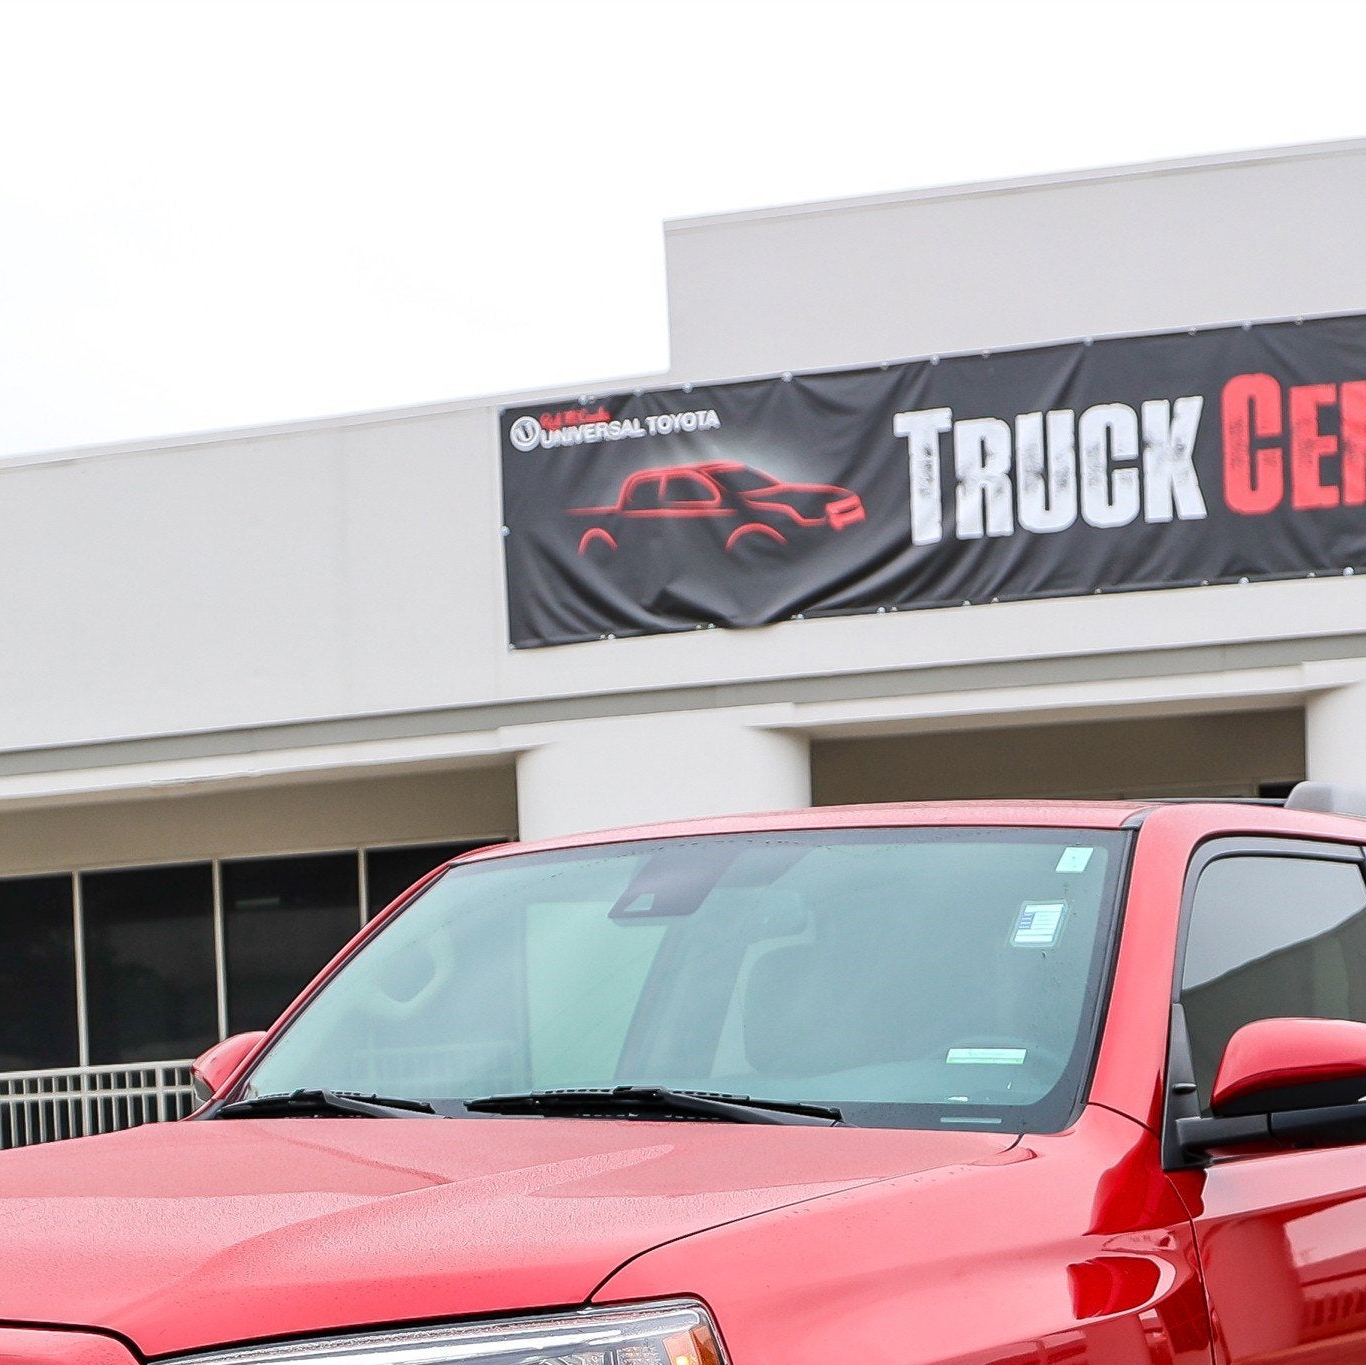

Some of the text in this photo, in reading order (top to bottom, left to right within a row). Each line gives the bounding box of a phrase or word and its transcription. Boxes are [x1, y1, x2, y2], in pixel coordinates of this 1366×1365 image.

[540, 417, 647, 449] UNIVERSAL
[645, 409, 722, 437] TOYOTA
[893, 395, 1208, 548] TRUCK
